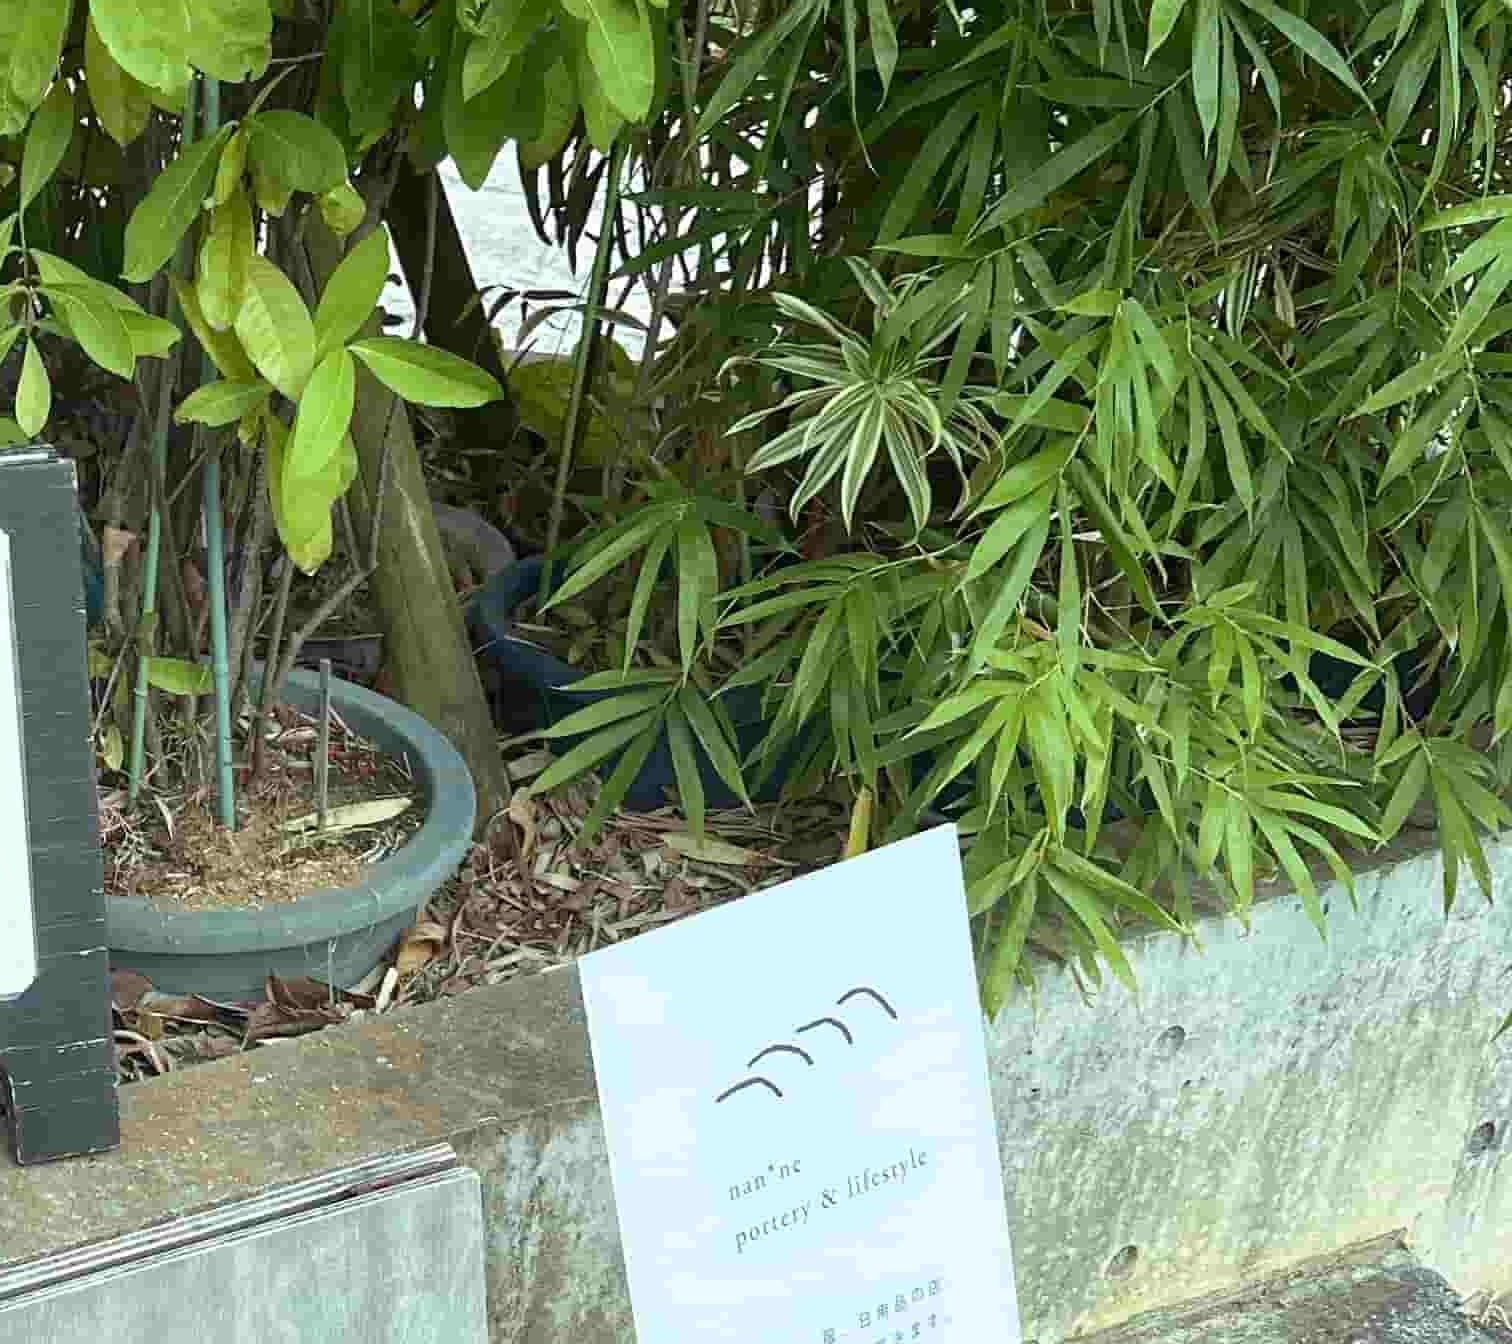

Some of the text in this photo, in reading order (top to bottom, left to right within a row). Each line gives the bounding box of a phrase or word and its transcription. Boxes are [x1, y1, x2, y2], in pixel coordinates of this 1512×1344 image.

[736, 1147, 928, 1254] pottery & lifestyle
